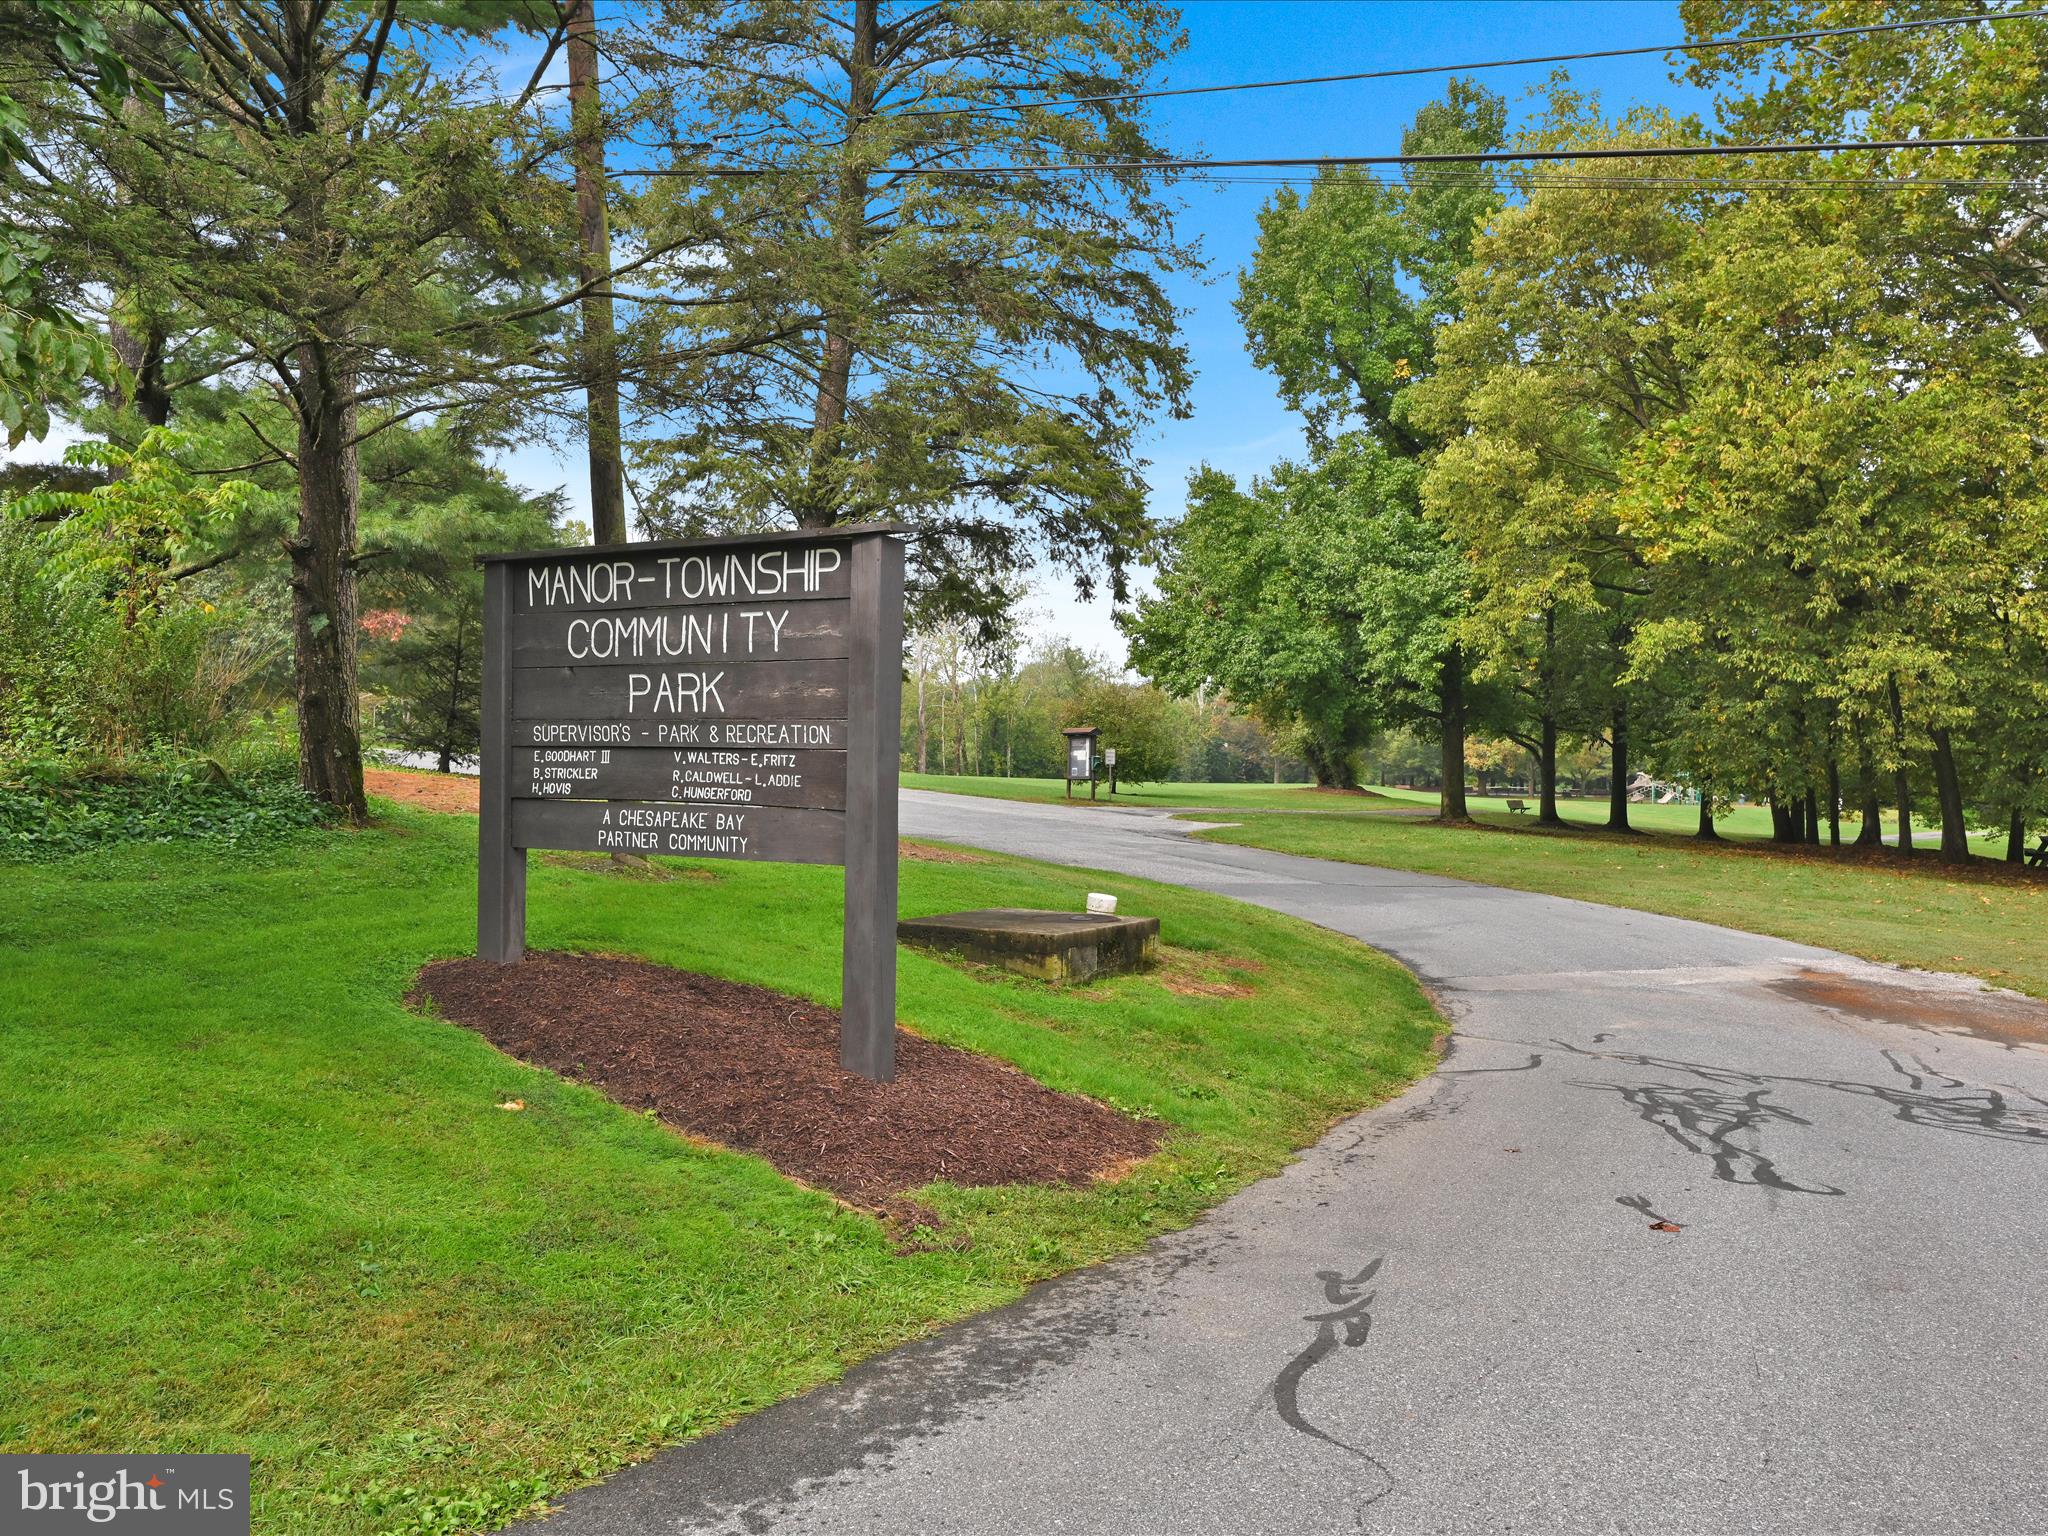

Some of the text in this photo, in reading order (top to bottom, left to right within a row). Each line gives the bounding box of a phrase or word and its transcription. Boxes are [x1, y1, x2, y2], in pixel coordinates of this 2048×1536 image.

[528, 549, 841, 607] MANOR-TOWNSHIP
[567, 609, 790, 659] COMMUNITY
[628, 671, 725, 714] PARK
[533, 723, 631, 743] SUPERVISOR'S
[658, 724, 700, 743] PARK
[709, 724, 720, 744] &
[725, 724, 832, 745] RECREATION
[600, 749, 611, 764] III
[602, 808, 745, 831] A CHESAPEAKE BAY
[598, 829, 748, 854] PARTNER COMMUNITY
